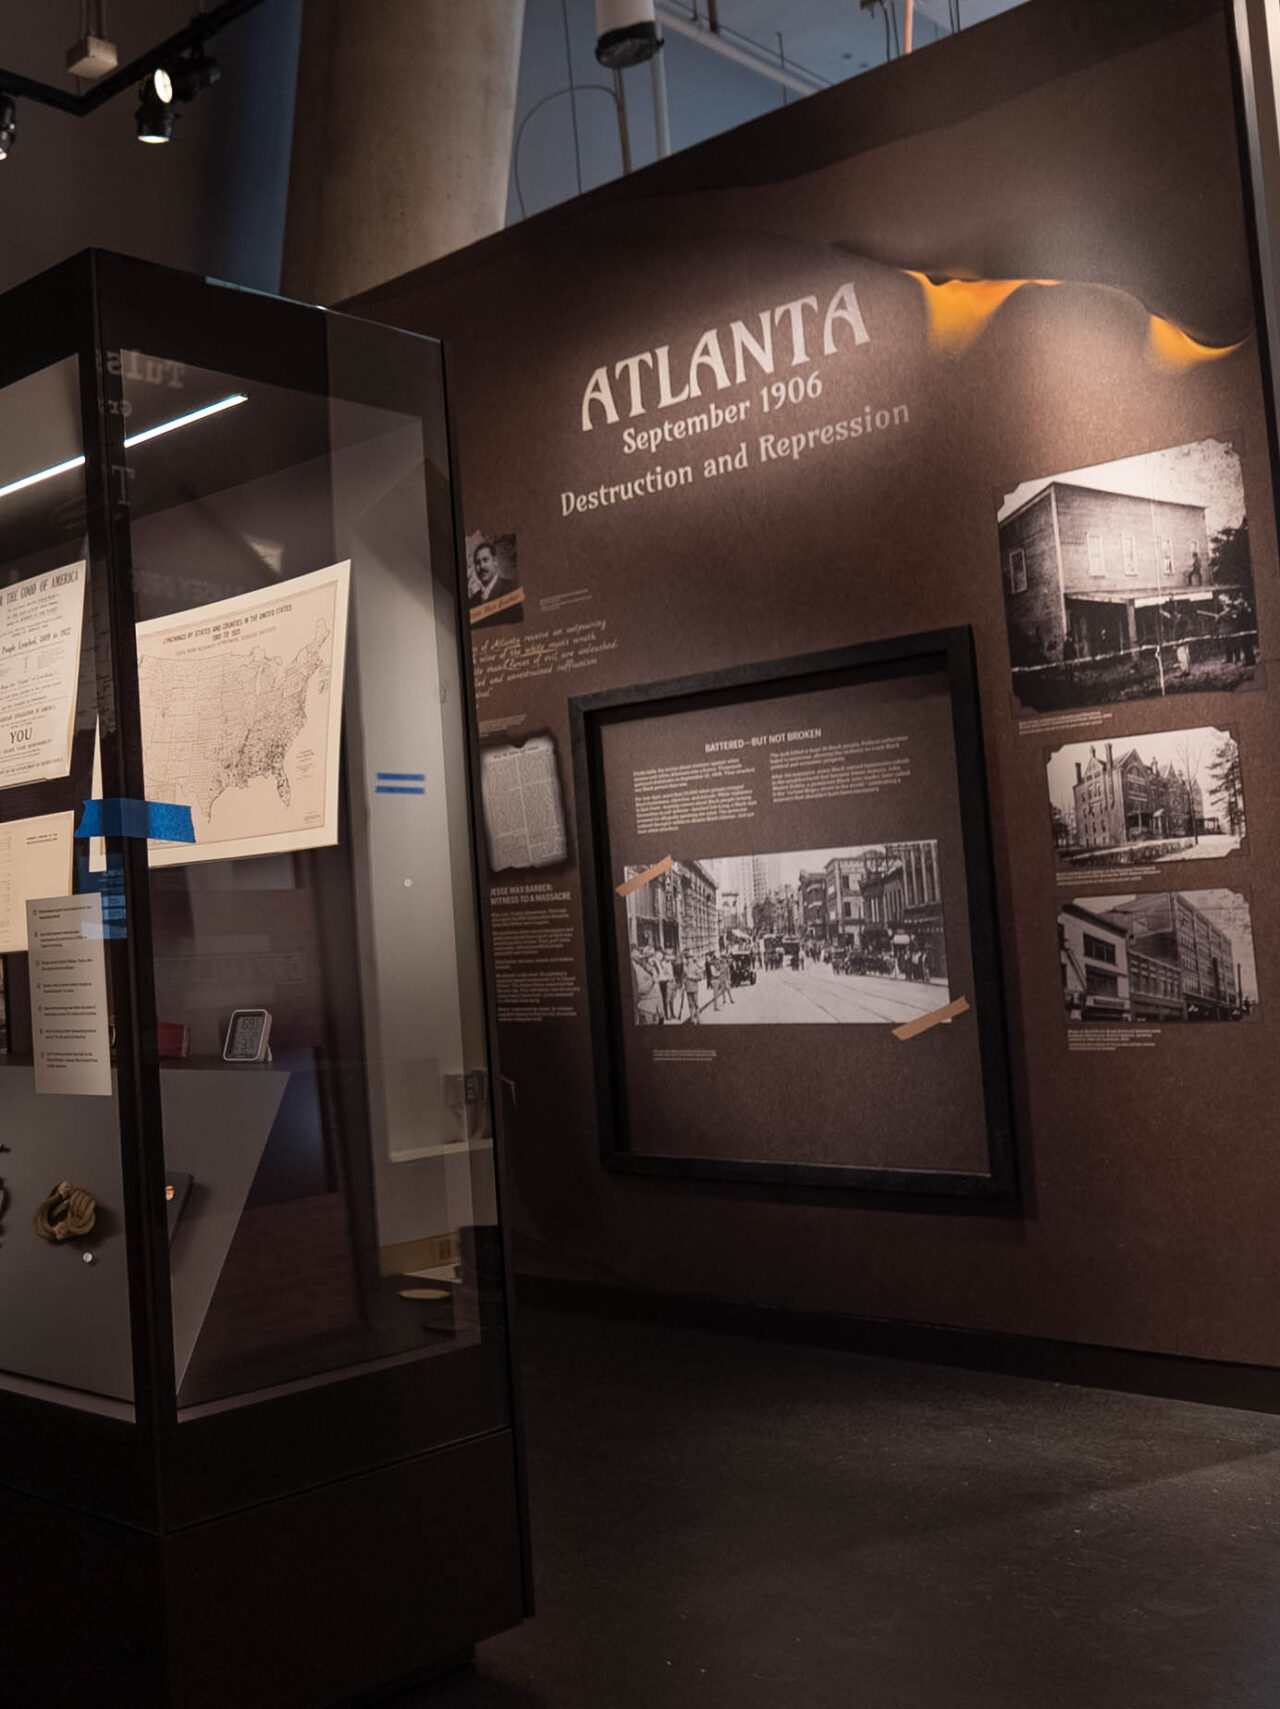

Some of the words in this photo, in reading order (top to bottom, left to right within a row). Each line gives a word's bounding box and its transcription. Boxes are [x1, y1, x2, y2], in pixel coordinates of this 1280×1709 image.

[580, 281, 871, 432] ATLANTA
[621, 398, 752, 455] September
[758, 369, 824, 414] 1906
[560, 465, 694, 518] Destruction
[702, 442, 750, 480] and
[758, 402, 911, 462] Repression
[9, 726, 33, 745] YOU
[768, 732, 786, 744] NOT
[787, 728, 822, 743] BROKEN
